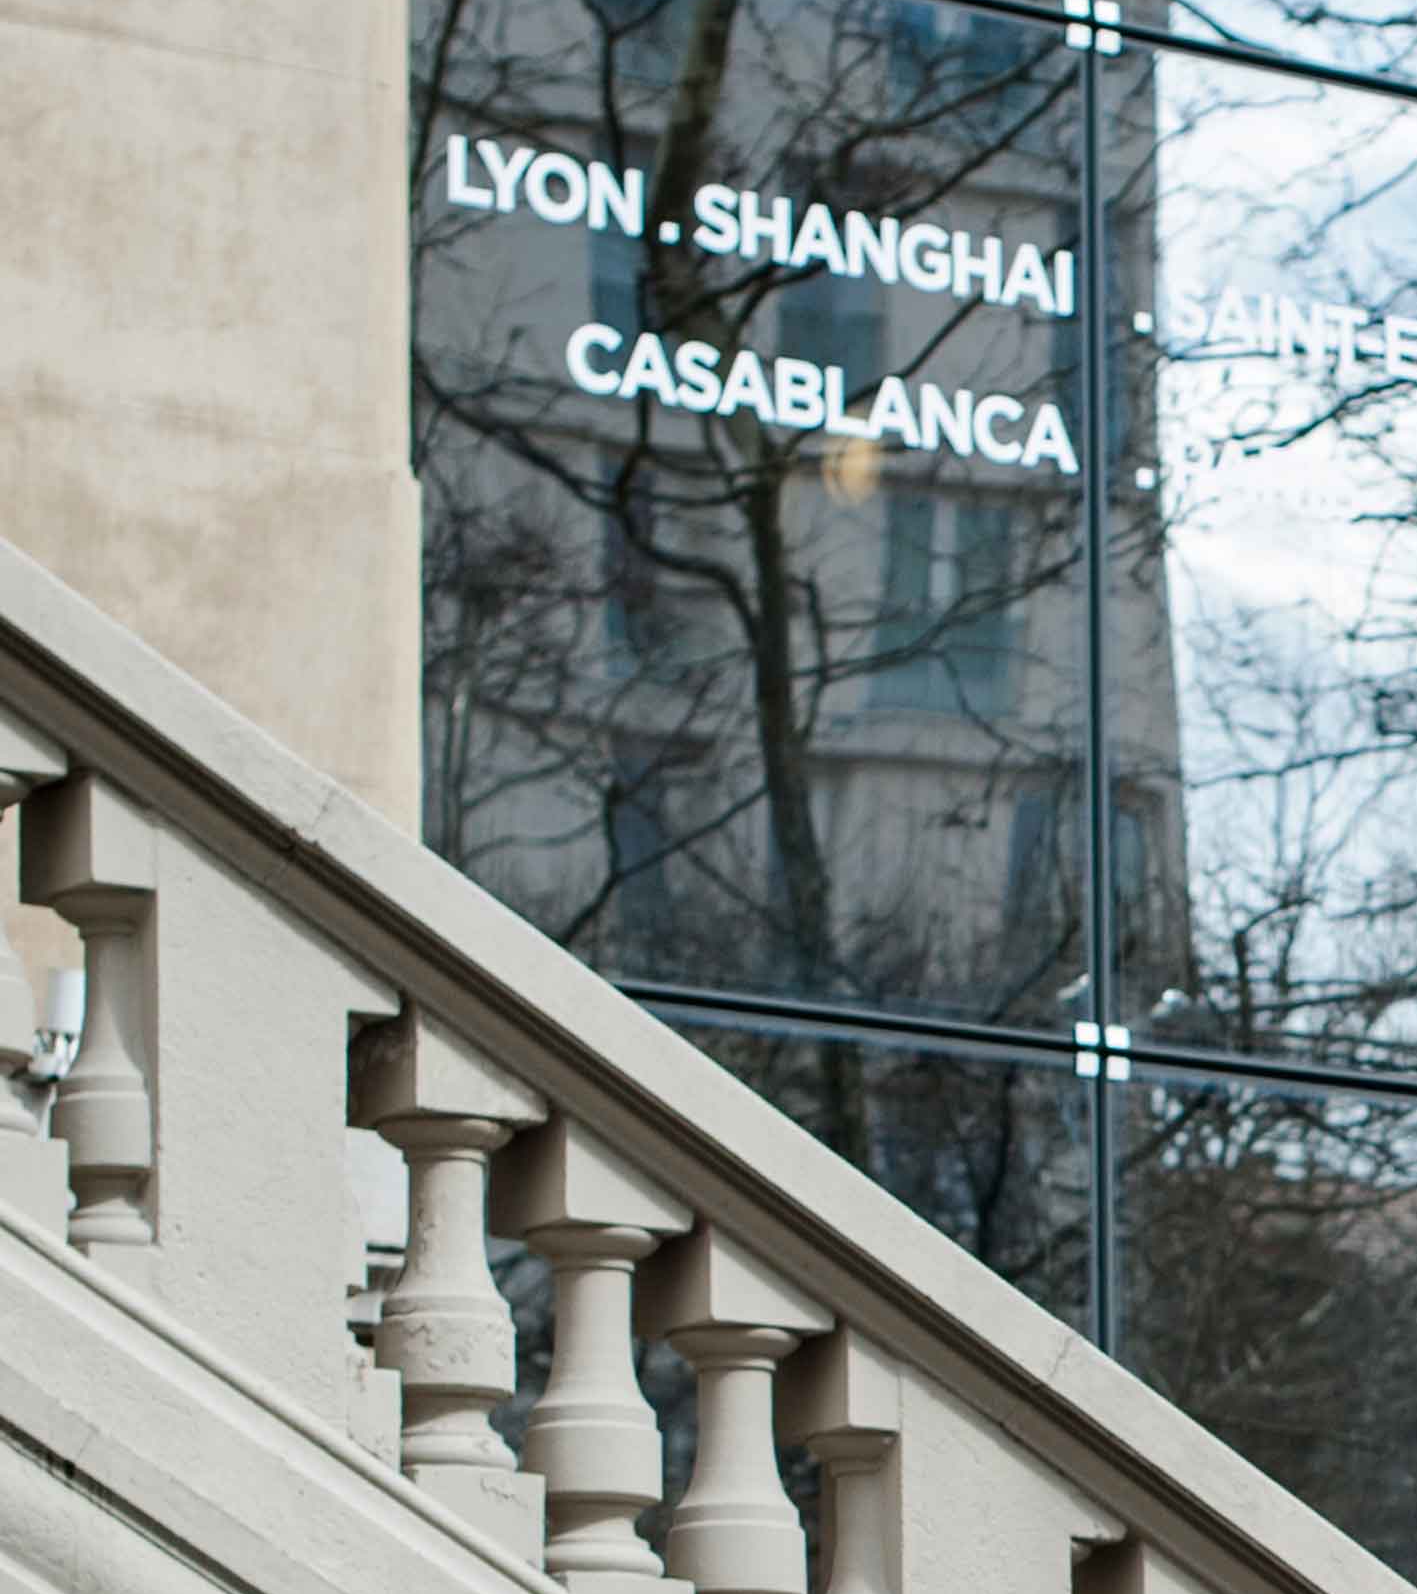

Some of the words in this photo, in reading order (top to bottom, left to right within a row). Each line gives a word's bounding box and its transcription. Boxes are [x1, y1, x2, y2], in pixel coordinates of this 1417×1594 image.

[446, 134, 644, 237] LYON
[693, 184, 1074, 316] SHANGHAI
[565, 323, 1079, 474] CASABLANCA
